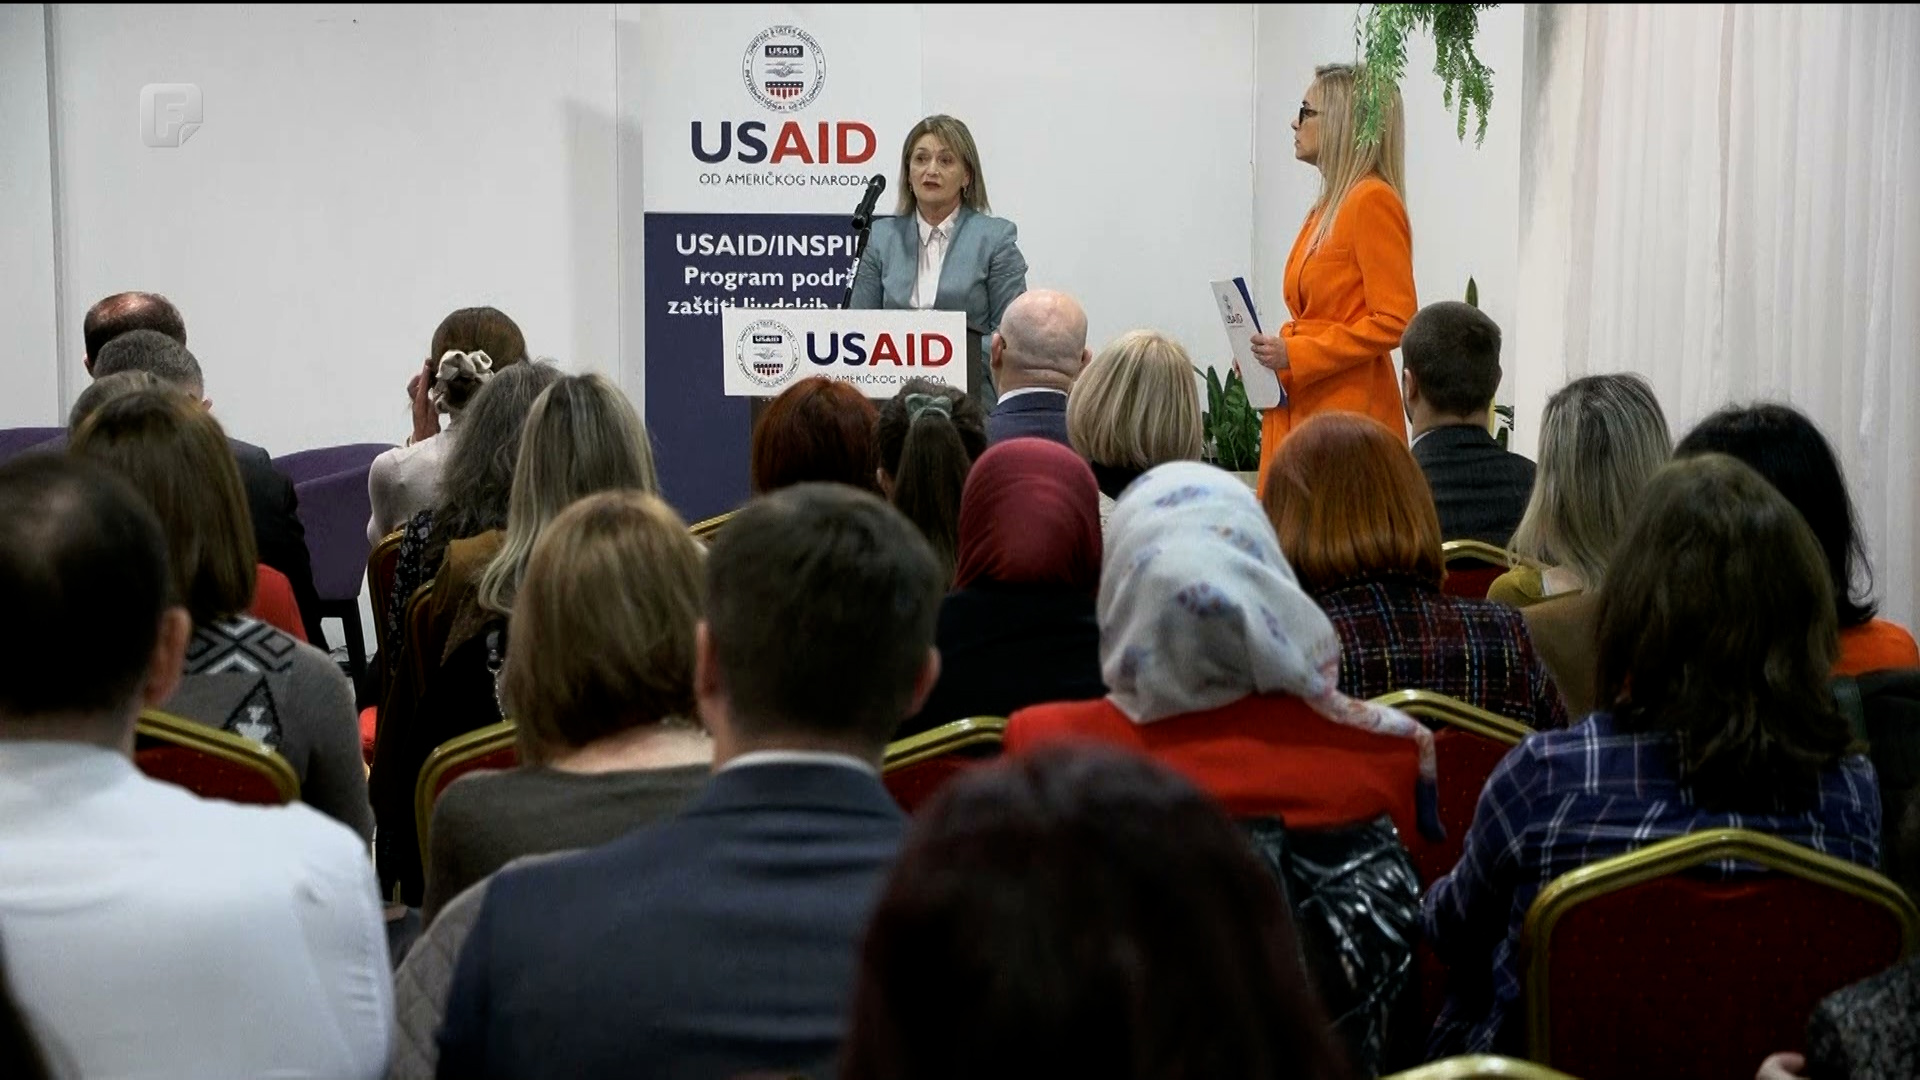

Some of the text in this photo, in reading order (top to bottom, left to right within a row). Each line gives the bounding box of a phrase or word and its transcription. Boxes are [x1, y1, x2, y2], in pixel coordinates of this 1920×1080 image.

[768, 47, 800, 55] USAID
[691, 121, 877, 163] USAID
[699, 171, 869, 186] OD AMERIČKOG NARODA
[684, 266, 784, 291] Program
[667, 295, 736, 315] zaštiti
[806, 331, 953, 366] USAID
